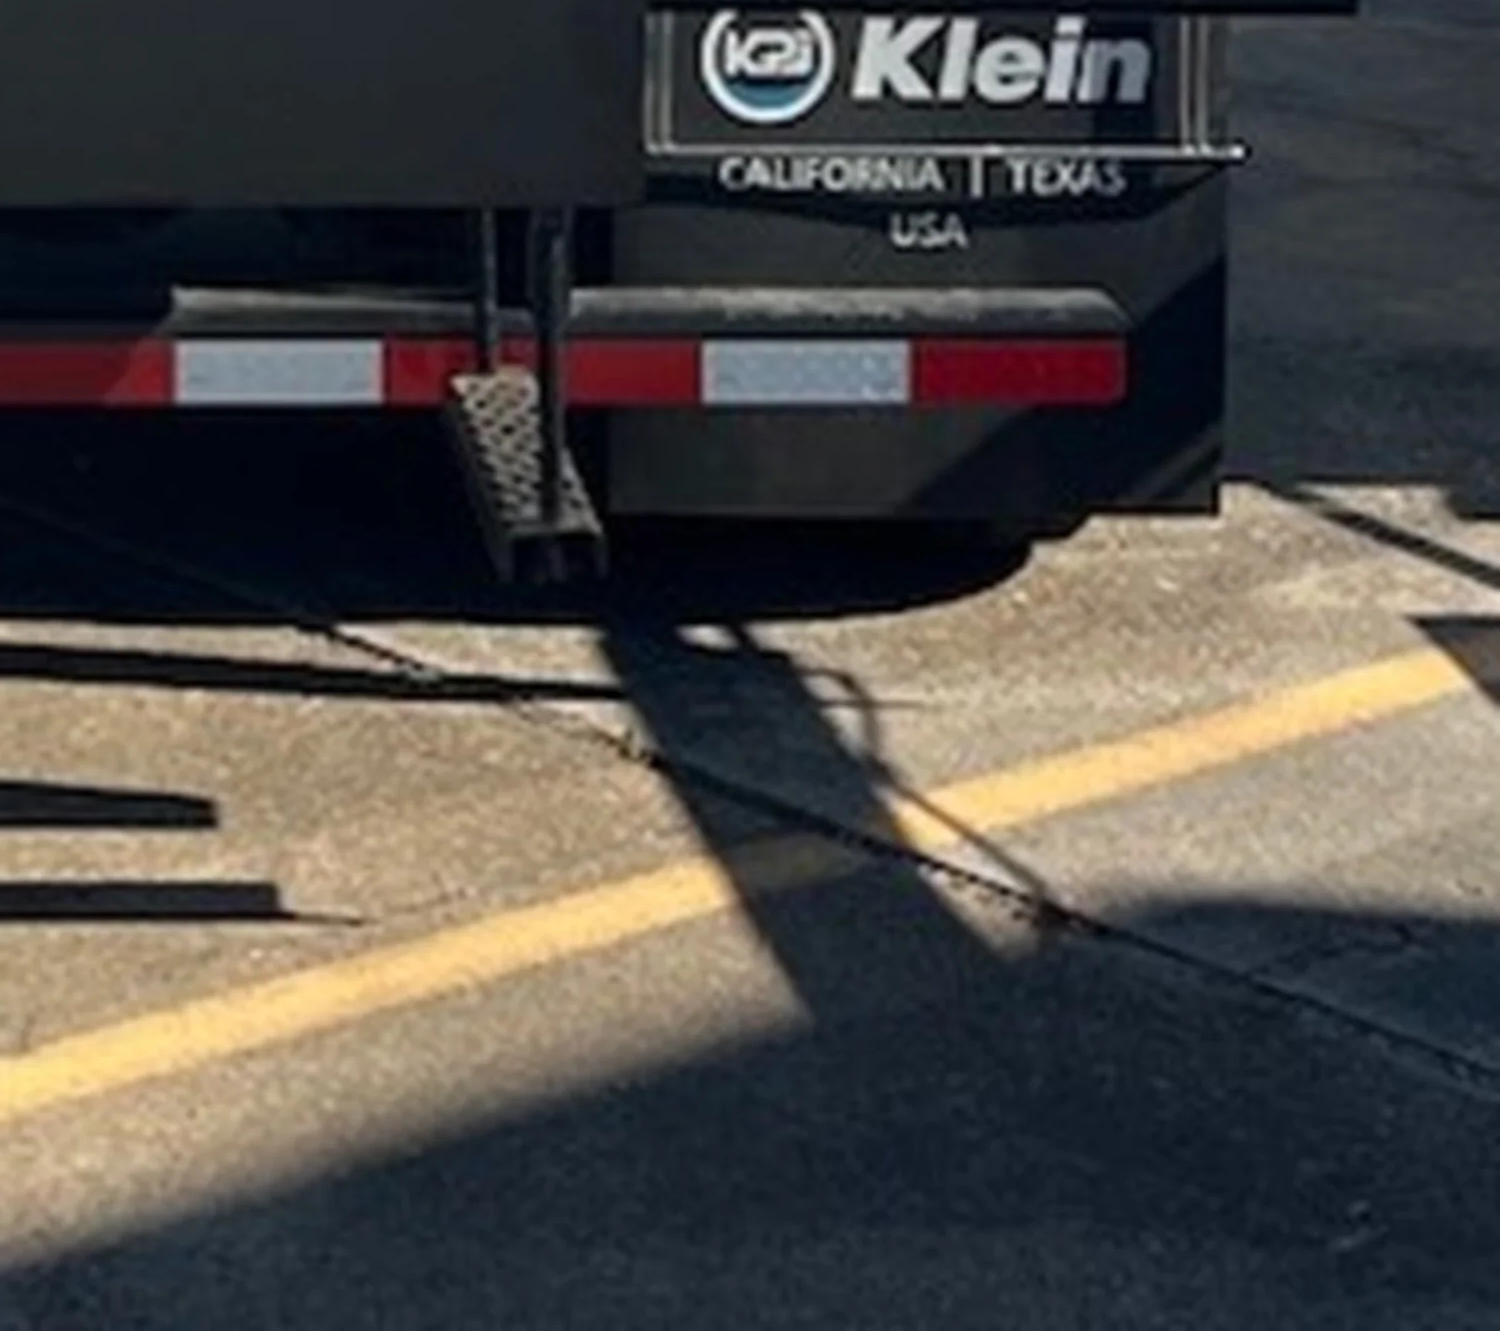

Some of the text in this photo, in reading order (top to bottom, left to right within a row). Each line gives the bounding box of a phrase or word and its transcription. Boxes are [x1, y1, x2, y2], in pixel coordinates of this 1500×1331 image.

[851, 15, 1152, 103] Klein
[717, 155, 946, 193] CALIFORNIA
[1006, 155, 1127, 196] TEXAS
[887, 212, 969, 249] USA
